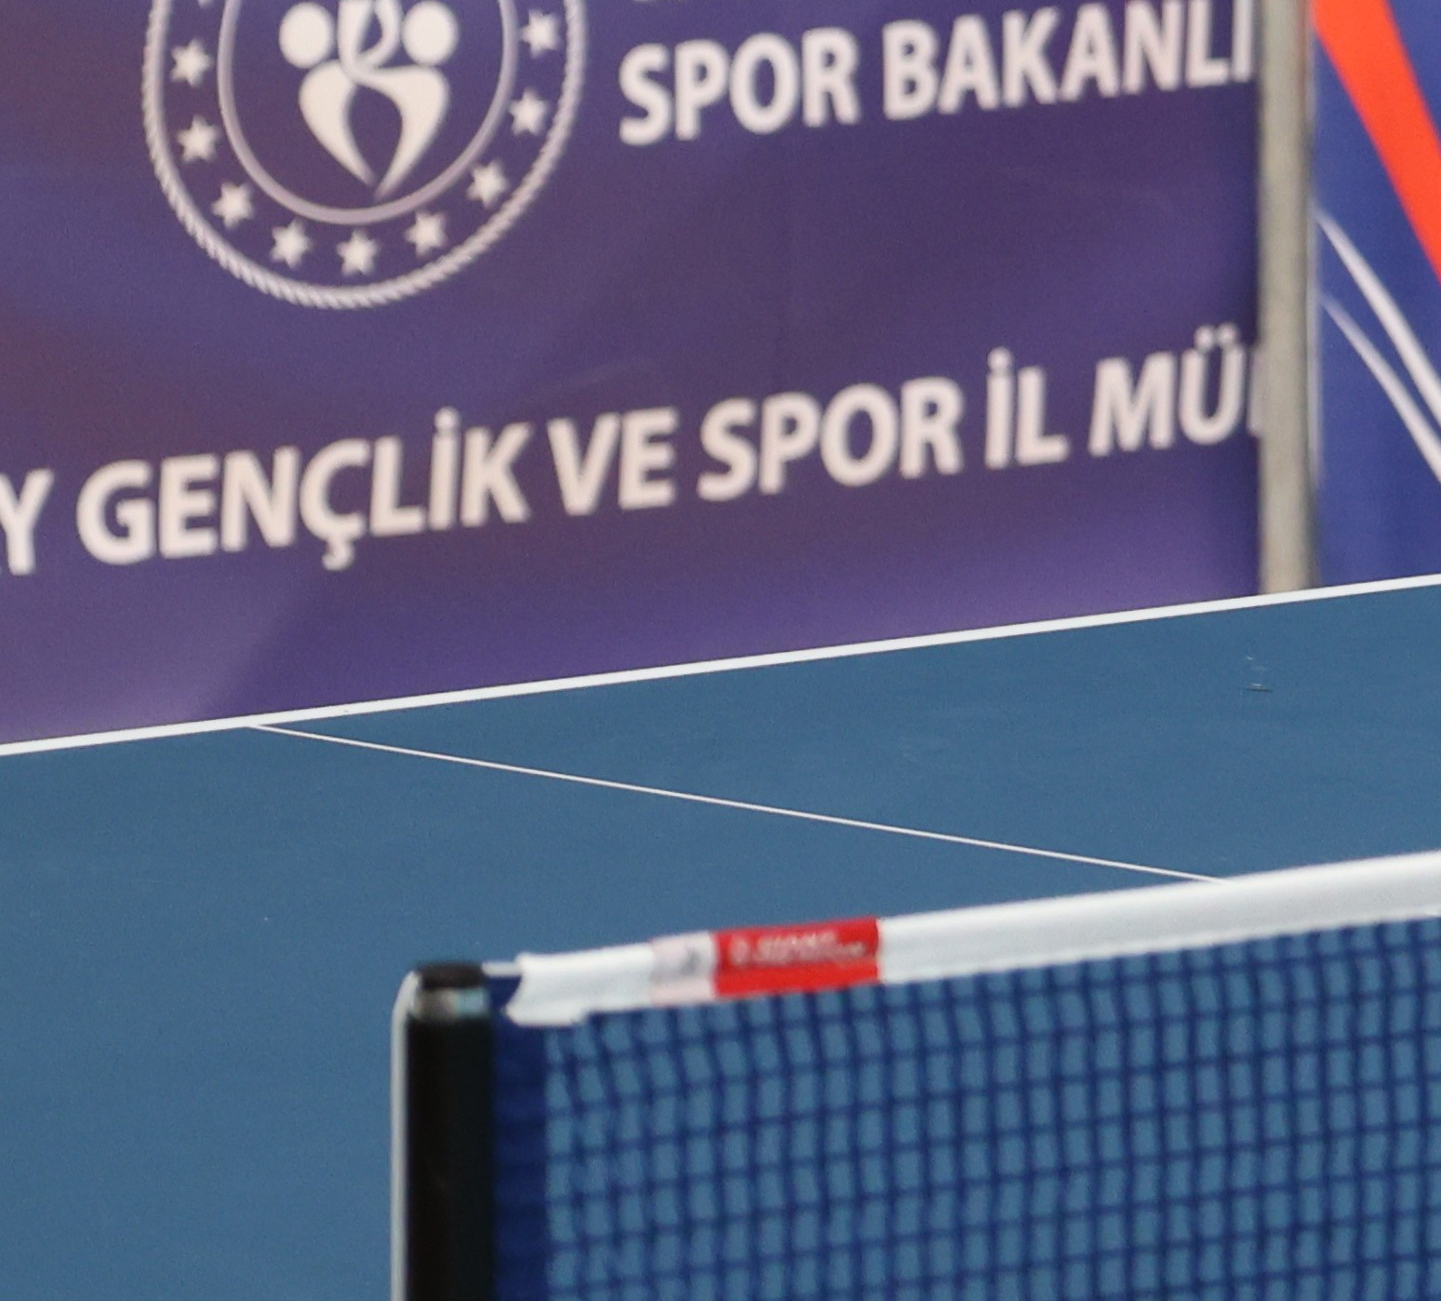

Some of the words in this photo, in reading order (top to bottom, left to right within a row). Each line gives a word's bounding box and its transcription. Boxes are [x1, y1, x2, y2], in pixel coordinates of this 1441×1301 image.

[618, 27, 861, 146] SPOR
[76, 406, 532, 571] GENÇLİK
[547, 406, 680, 516] VE
[696, 377, 964, 501] SPOR
[984, 346, 1070, 469] İL
